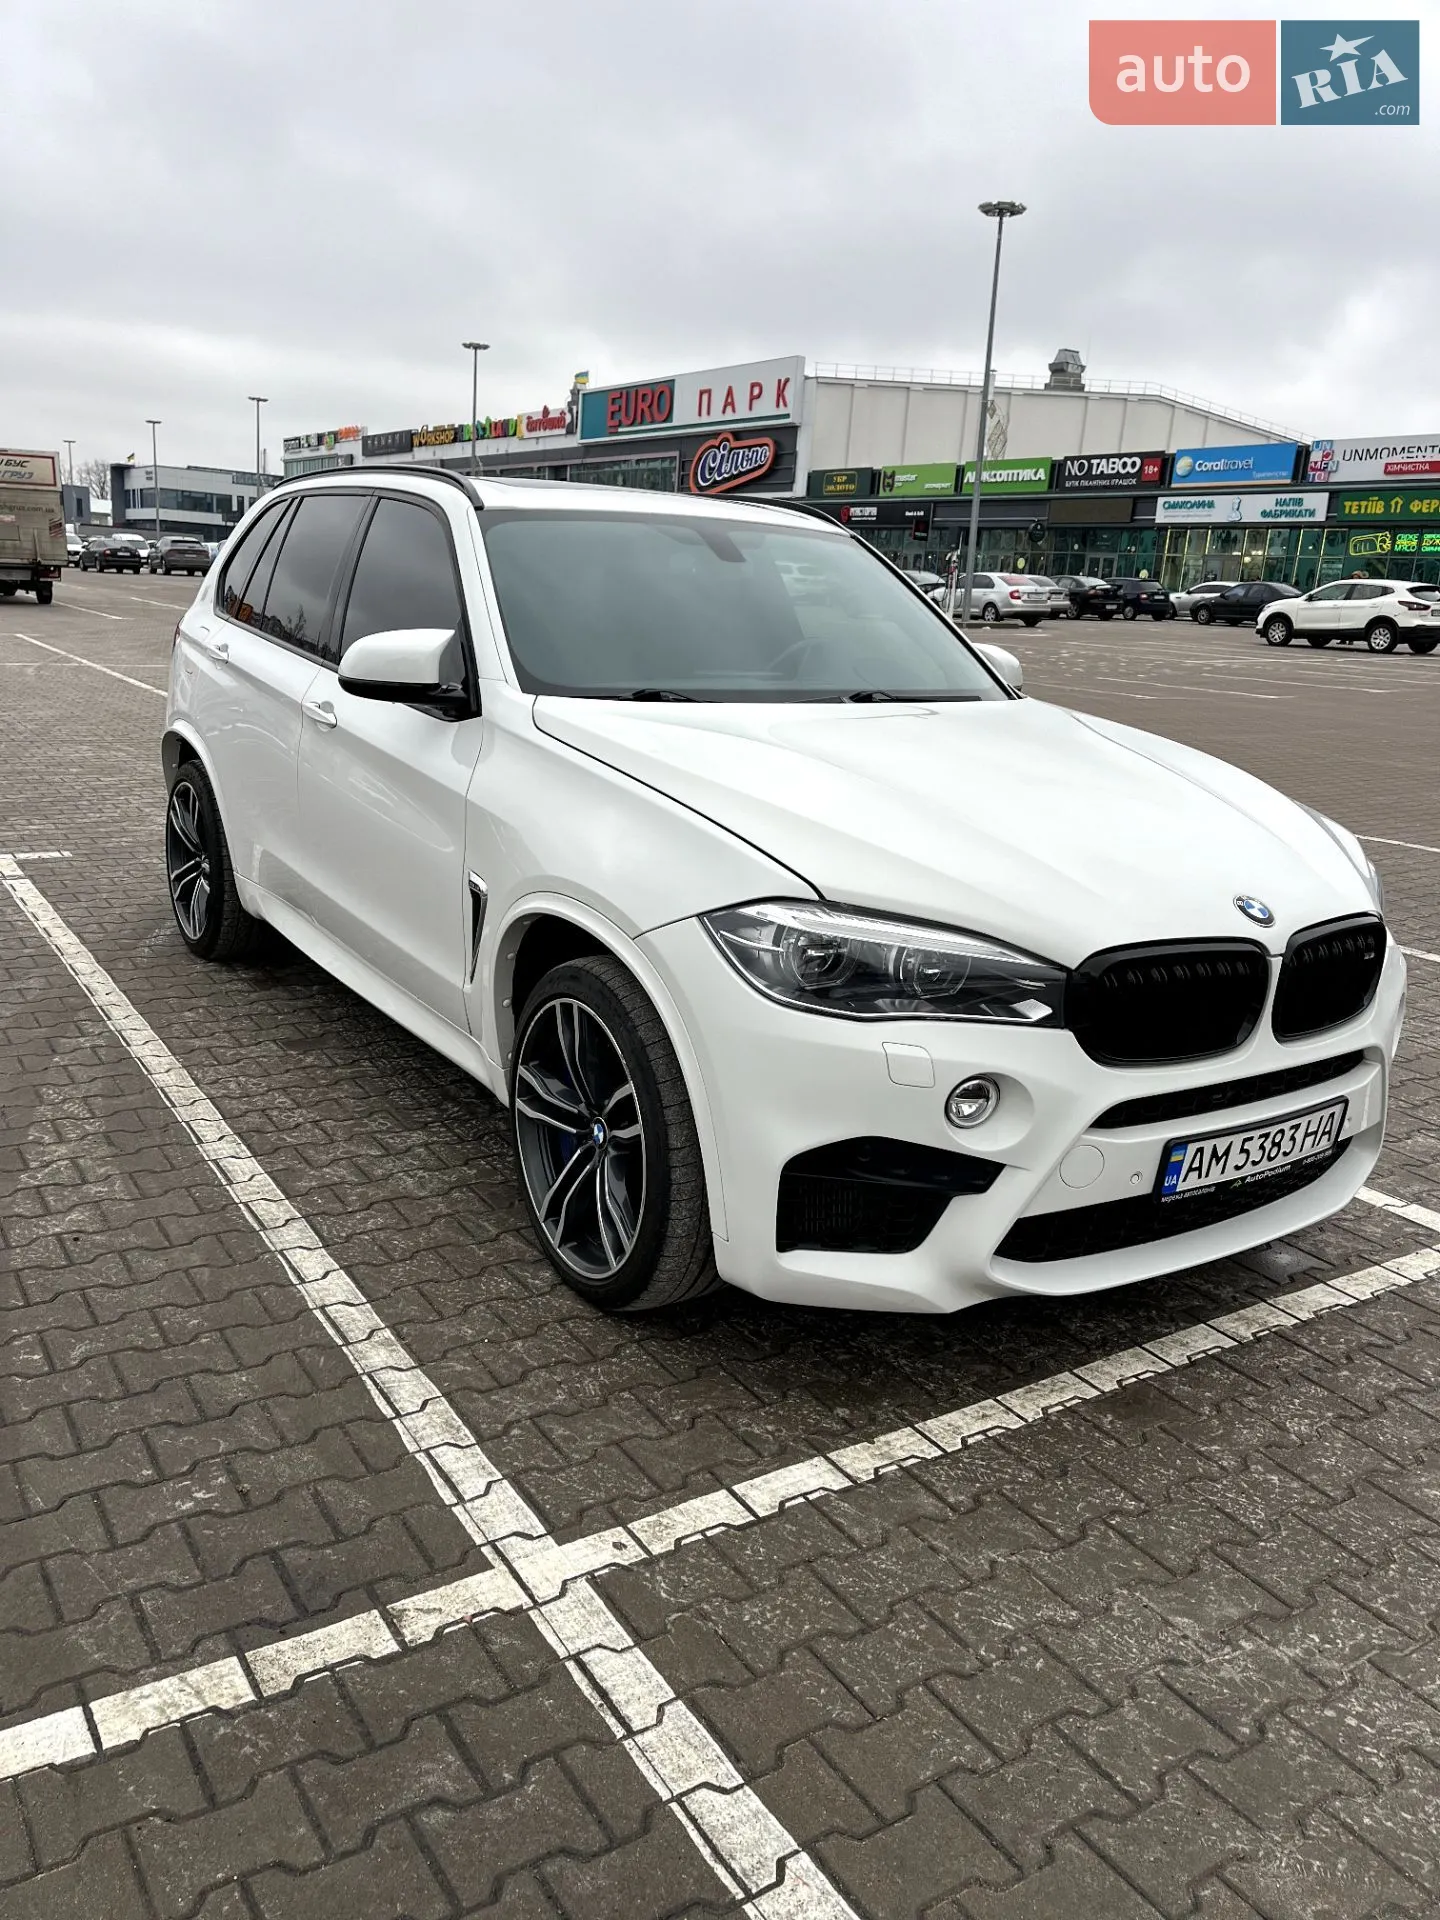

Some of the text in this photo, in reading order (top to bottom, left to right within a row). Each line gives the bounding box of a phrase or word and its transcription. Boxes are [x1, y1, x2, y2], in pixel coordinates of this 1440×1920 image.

[697, 377, 791, 417] ПАРК
[607, 383, 672, 428] EURO
[412, 424, 455, 447] WORKSHOP
[697, 441, 770, 487] Сільпо
[1065, 457, 1141, 476] NO TABOO
[1144, 465, 1158, 474] 18+
[1386, 462, 1430, 473] ХІМЧИСТКА
[1275, 497, 1304, 508] НАПІВ
[1409, 499, 1440, 513] ФЕР
[1260, 508, 1316, 518] ФАБРИКАТИ
[1164, 1174, 1177, 1187] UA
[1245, 1164, 1291, 1183] AutoPodium
